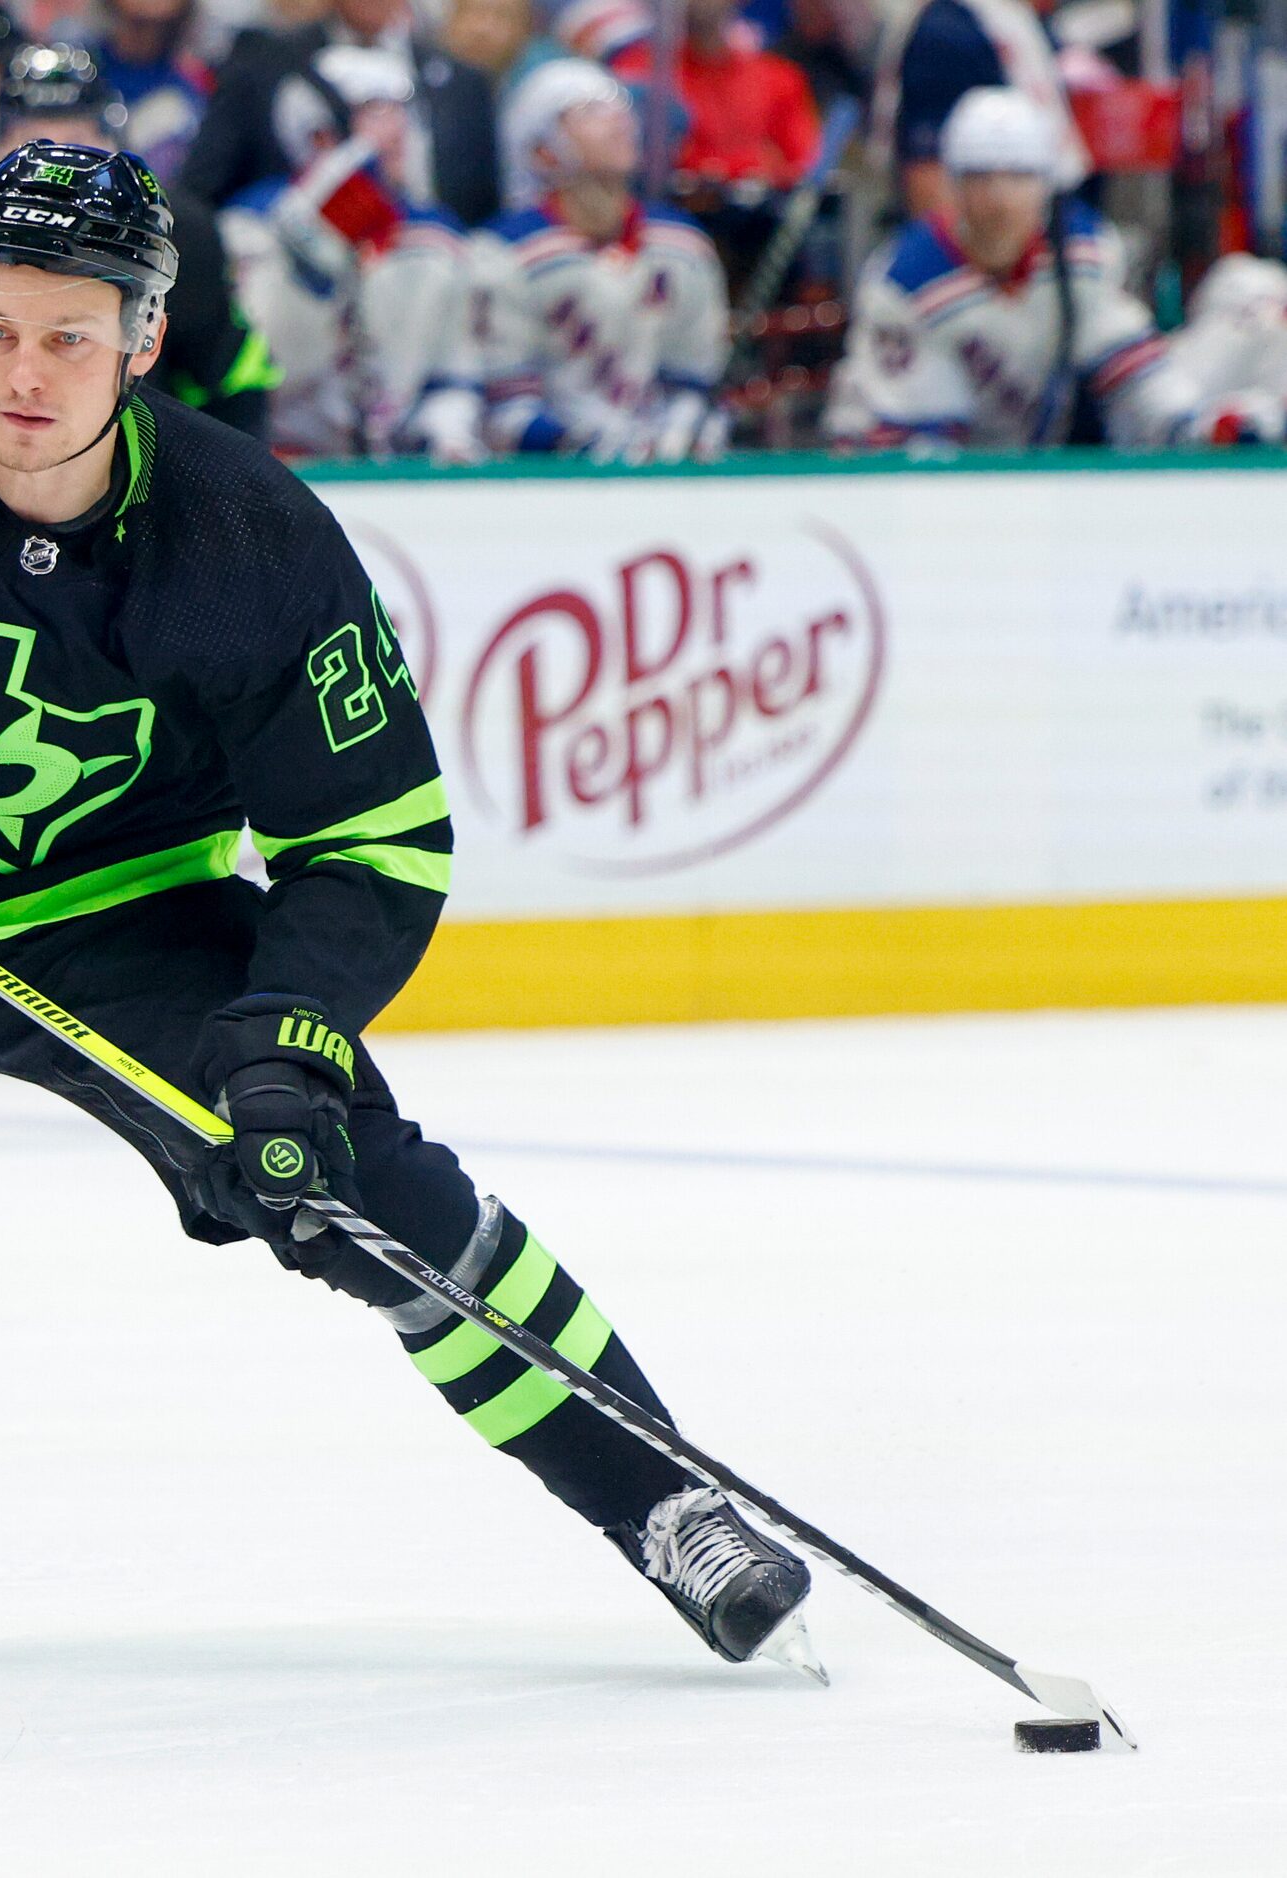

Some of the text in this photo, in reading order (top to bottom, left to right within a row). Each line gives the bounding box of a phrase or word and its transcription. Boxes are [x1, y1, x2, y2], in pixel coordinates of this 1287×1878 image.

[2, 205, 77, 229] CCM
[619, 551, 755, 686] Dr
[509, 588, 852, 834] Pepper
[116, 1056, 146, 1078] HINTZ
[419, 1268, 476, 1309] ALPHA
